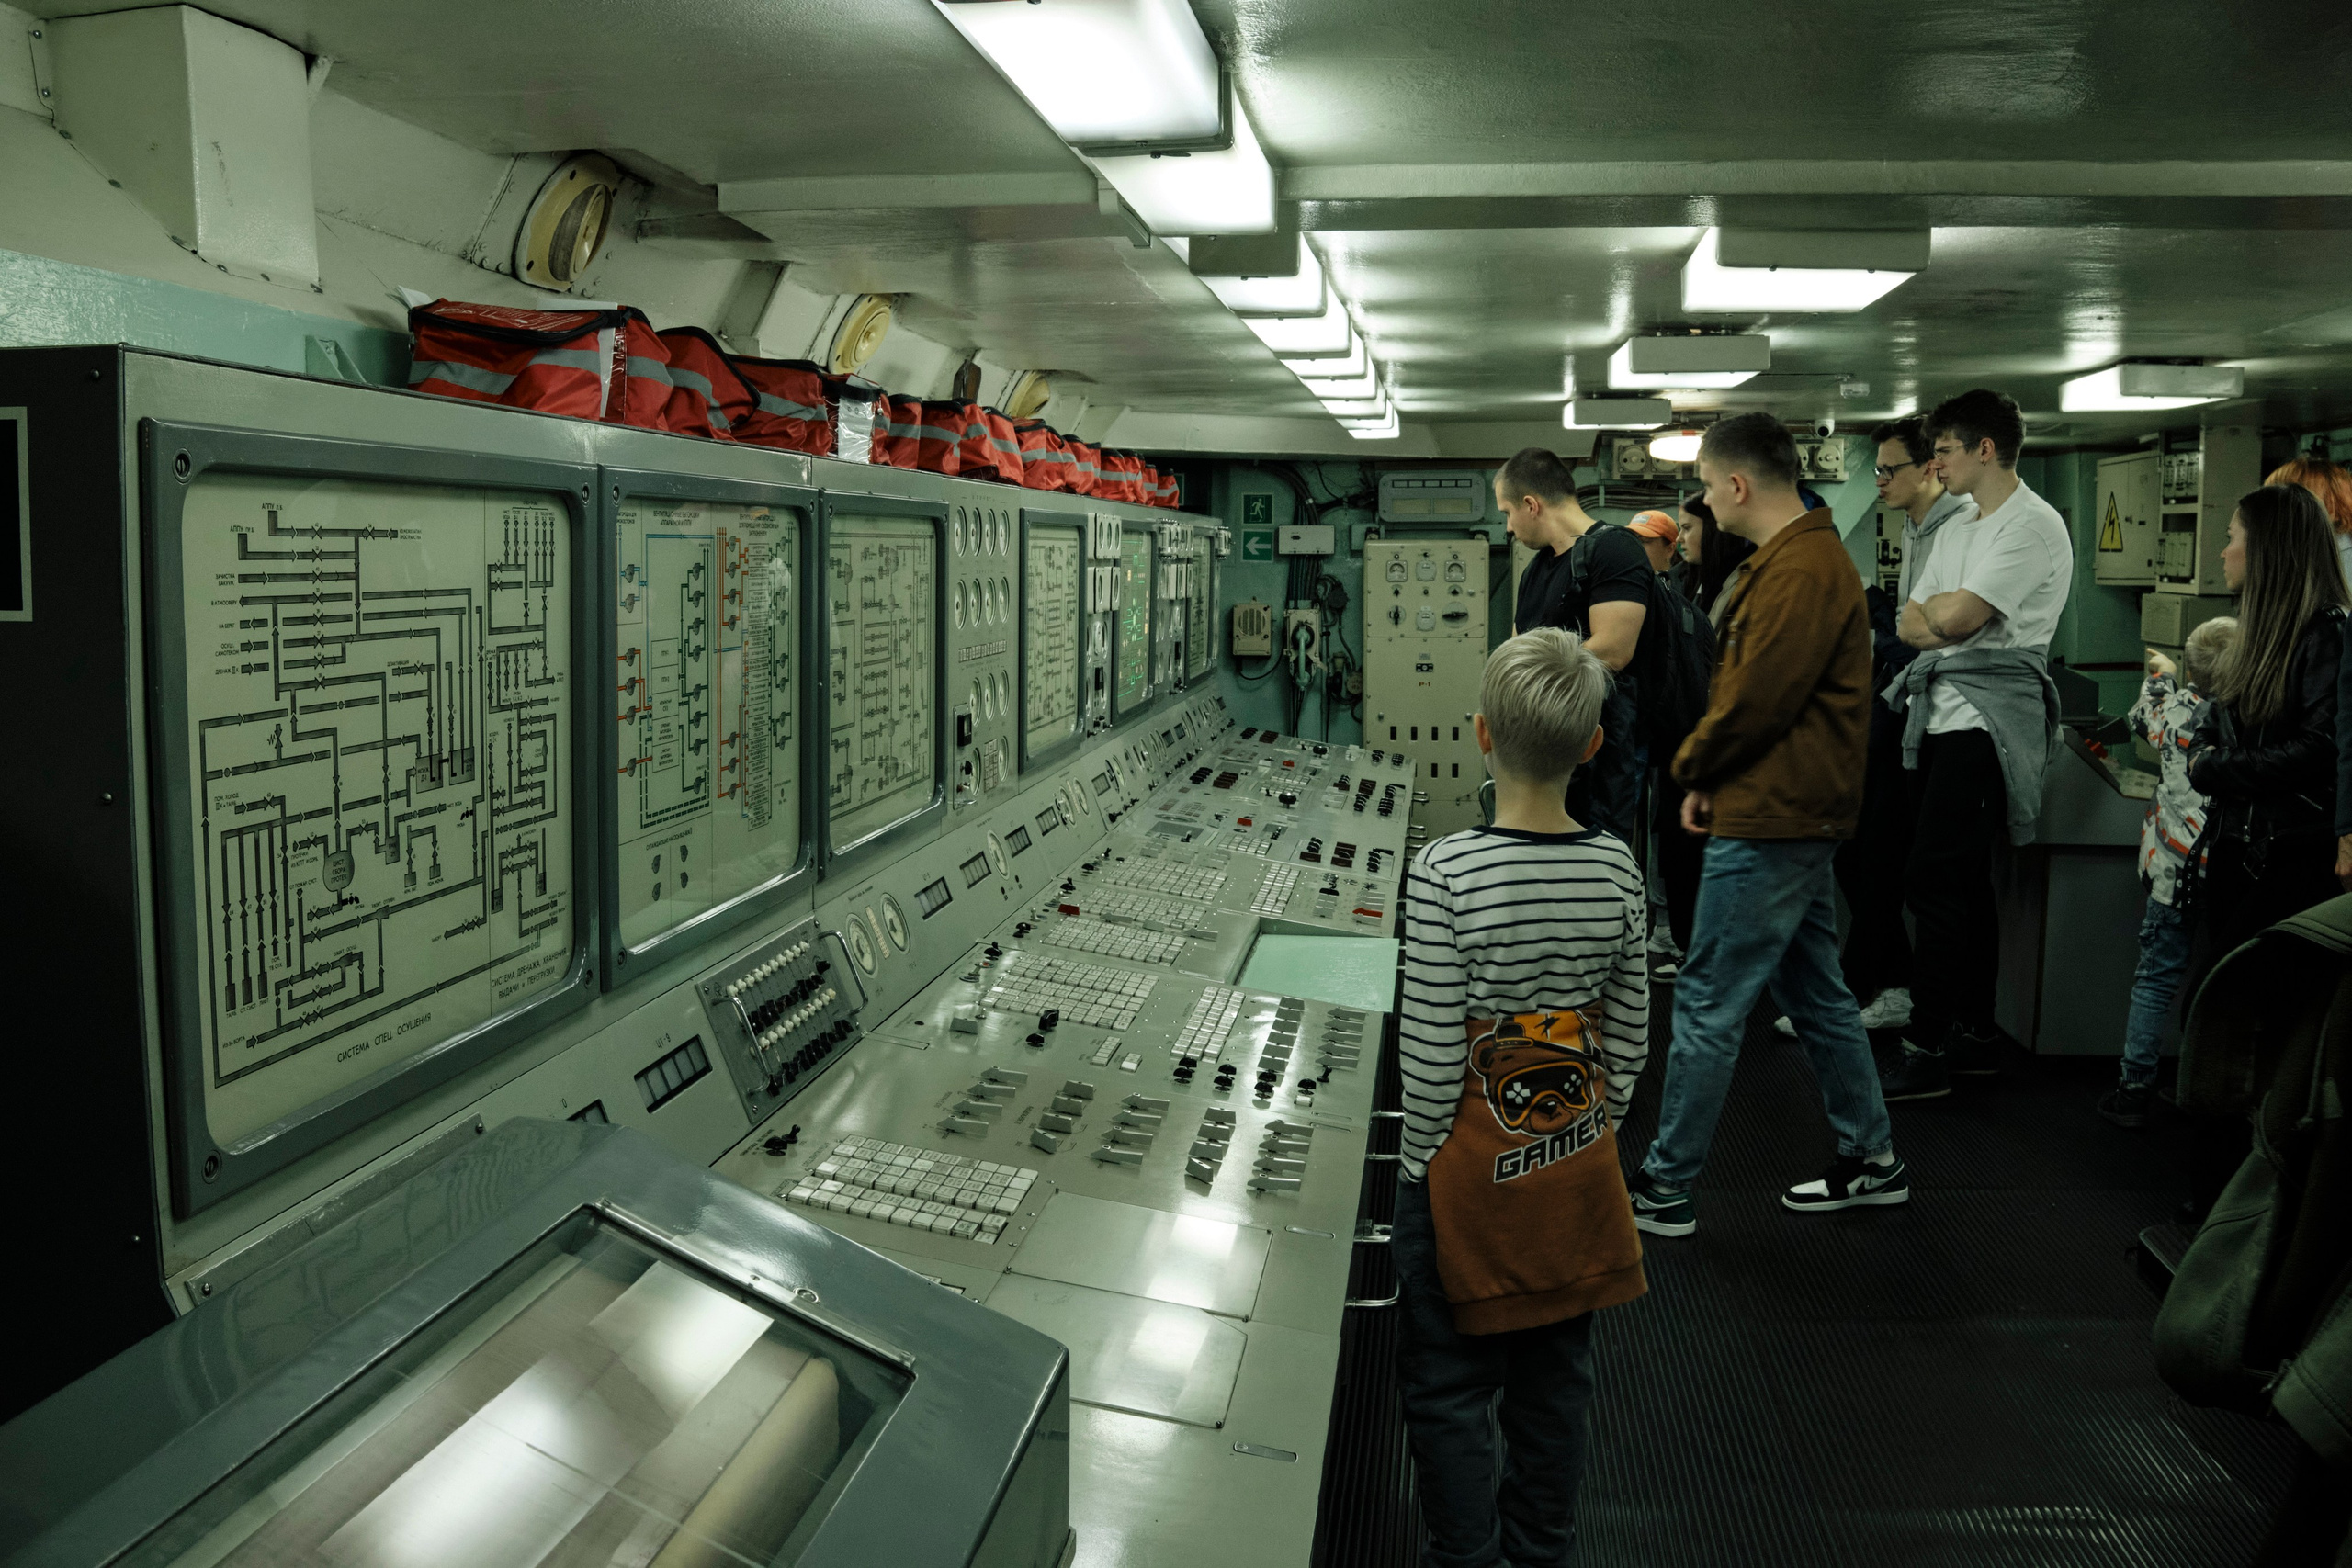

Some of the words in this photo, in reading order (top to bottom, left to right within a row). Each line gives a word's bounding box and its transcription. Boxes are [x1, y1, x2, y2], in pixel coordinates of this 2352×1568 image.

[491, 971, 515, 988] СИСТЕМА
[498, 983, 520, 999] ВЫДАЧИ
[526, 965, 556, 986] ПЕРЕГРУЗКИ
[337, 1041, 370, 1063] СИСТЕМА
[397, 1012, 432, 1035] ОСУШЕНИЯ
[1493, 1100, 1609, 1183] GAMER
